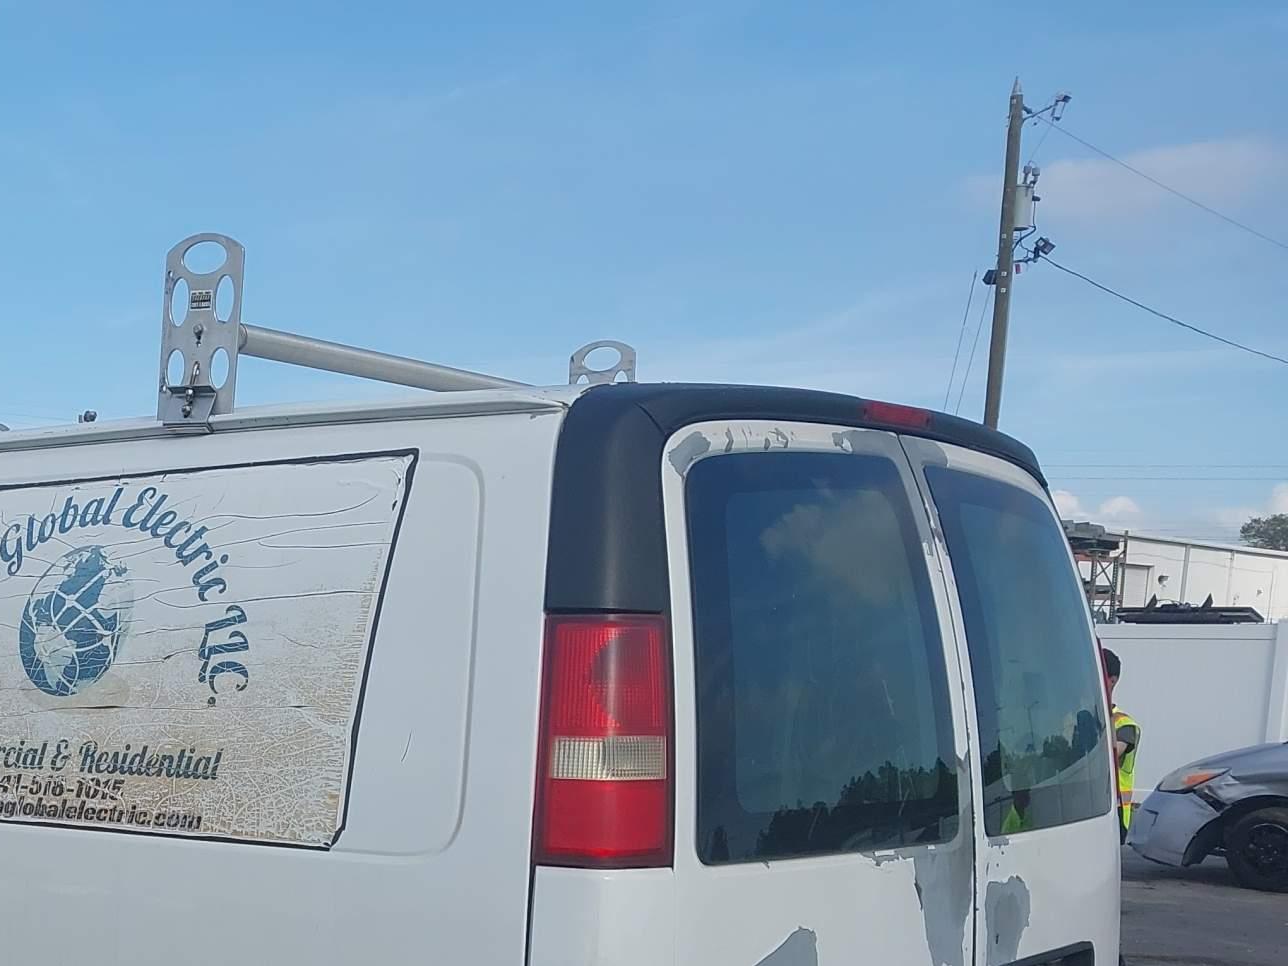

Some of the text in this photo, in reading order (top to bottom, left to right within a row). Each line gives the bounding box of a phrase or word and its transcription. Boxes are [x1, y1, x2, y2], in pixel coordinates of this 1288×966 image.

[0, 487, 125, 577] Global
[121, 486, 230, 602] Electric
[50, 739, 72, 772] &
[79, 740, 224, 780] Residential
